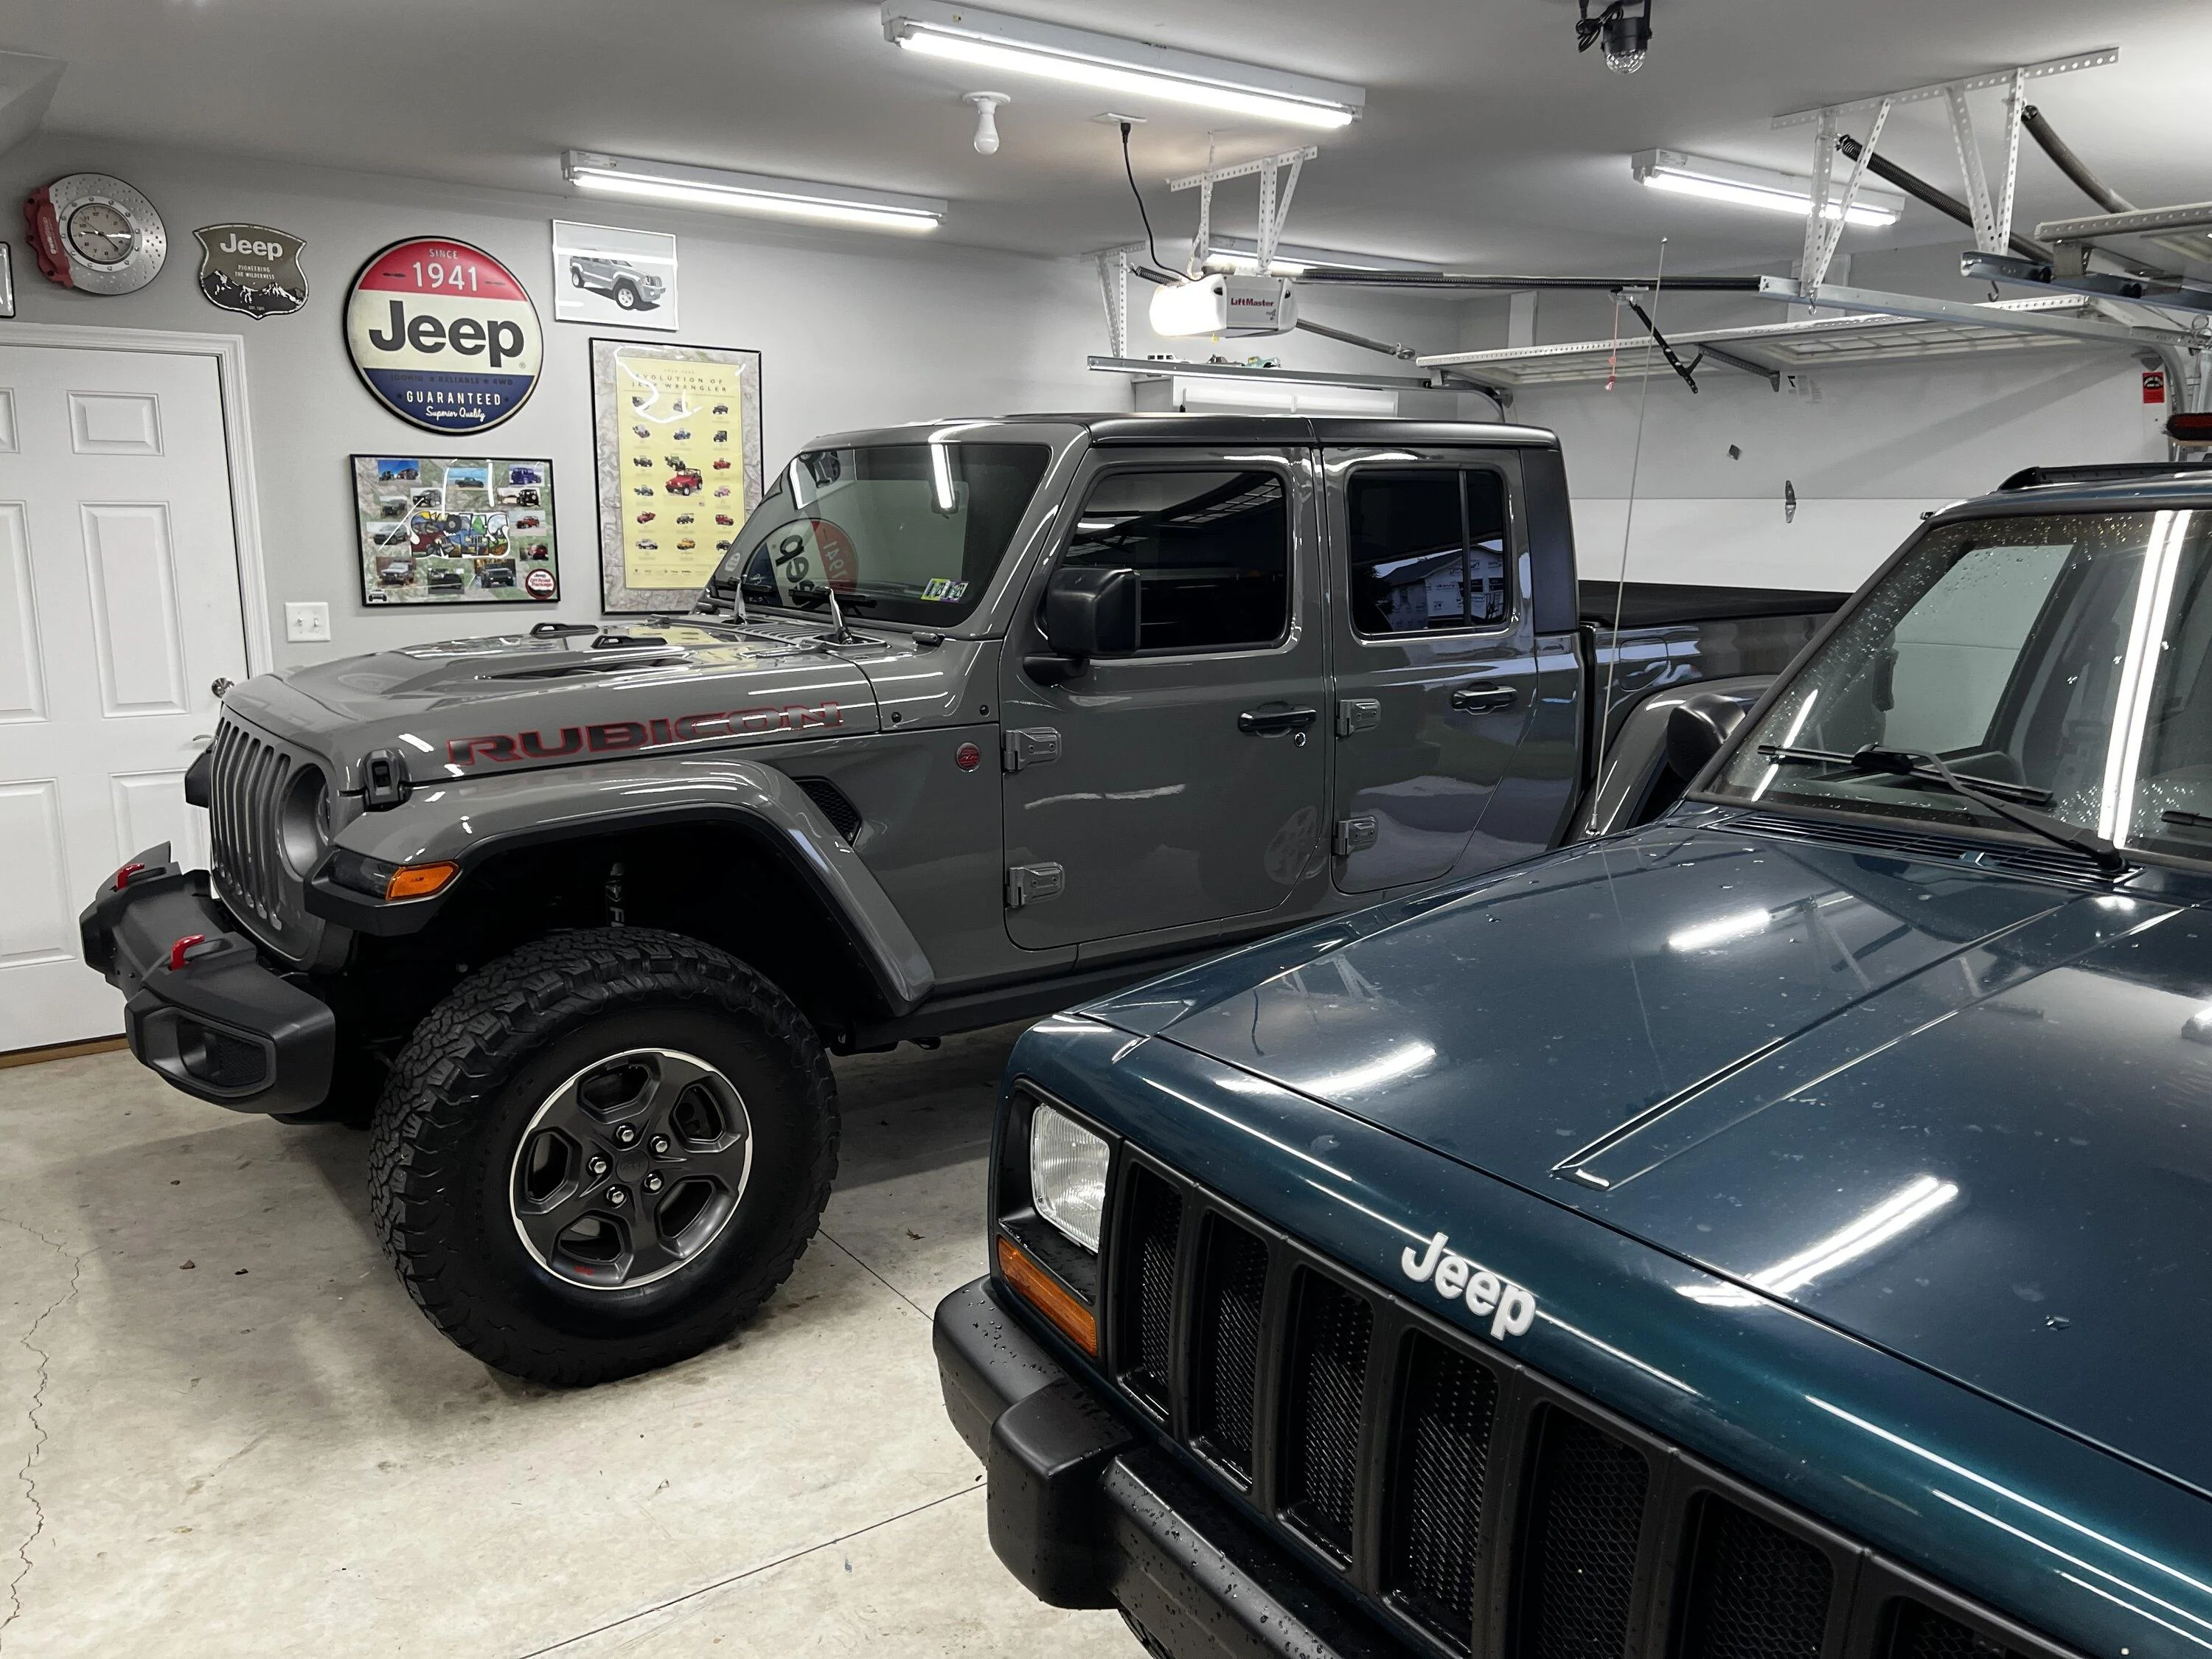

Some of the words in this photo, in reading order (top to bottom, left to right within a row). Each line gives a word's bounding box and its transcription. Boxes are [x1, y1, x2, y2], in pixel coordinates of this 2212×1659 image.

[220, 233, 283, 261] Jeep
[428, 248, 459, 260] SINCE
[237, 265, 271, 273] PIONEERING
[413, 261, 478, 292] 1941
[1231, 297, 1274, 307] LiftMaster
[369, 299, 524, 368] Jeep
[664, 383, 727, 392] WRANGLER
[406, 390, 501, 406] GUARANTEED
[425, 406, 458, 421] Superior
[459, 407, 486, 422] Quality
[447, 701, 843, 766] RUBICON
[1401, 1231, 1537, 1341] Jeep
